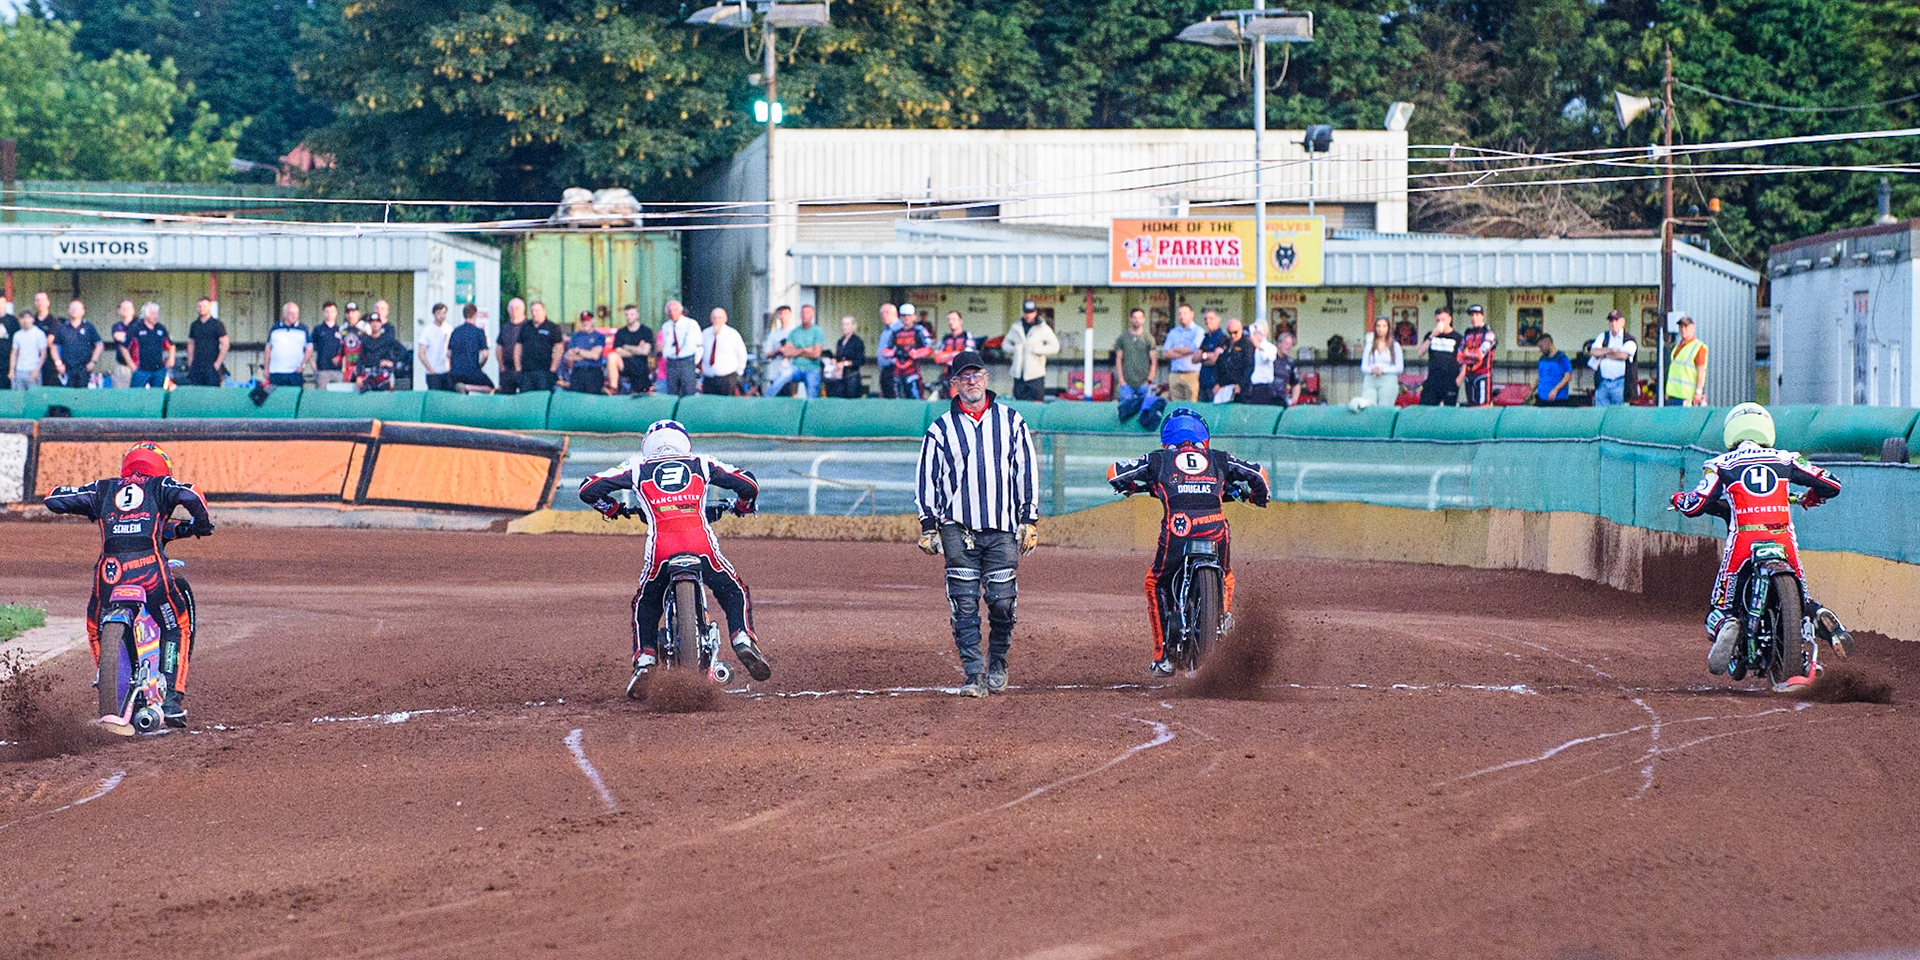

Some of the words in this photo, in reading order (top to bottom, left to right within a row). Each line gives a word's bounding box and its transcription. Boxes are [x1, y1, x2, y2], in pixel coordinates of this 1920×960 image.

[1142, 222, 1181, 232] HOME
[1187, 222, 1203, 232] OF
[1210, 222, 1235, 232] THE
[59, 241, 149, 255] VISITORS
[1159, 239, 1239, 256] PARRYS
[1157, 256, 1241, 267] INTERNATIONAL
[1186, 453, 1197, 468] 6
[660, 466, 684, 487] 3
[1750, 467, 1768, 492] 4
[123, 486, 133, 505] 5
[1177, 484, 1212, 494] DOUGLAS
[112, 522, 143, 534] SCHLEIN
